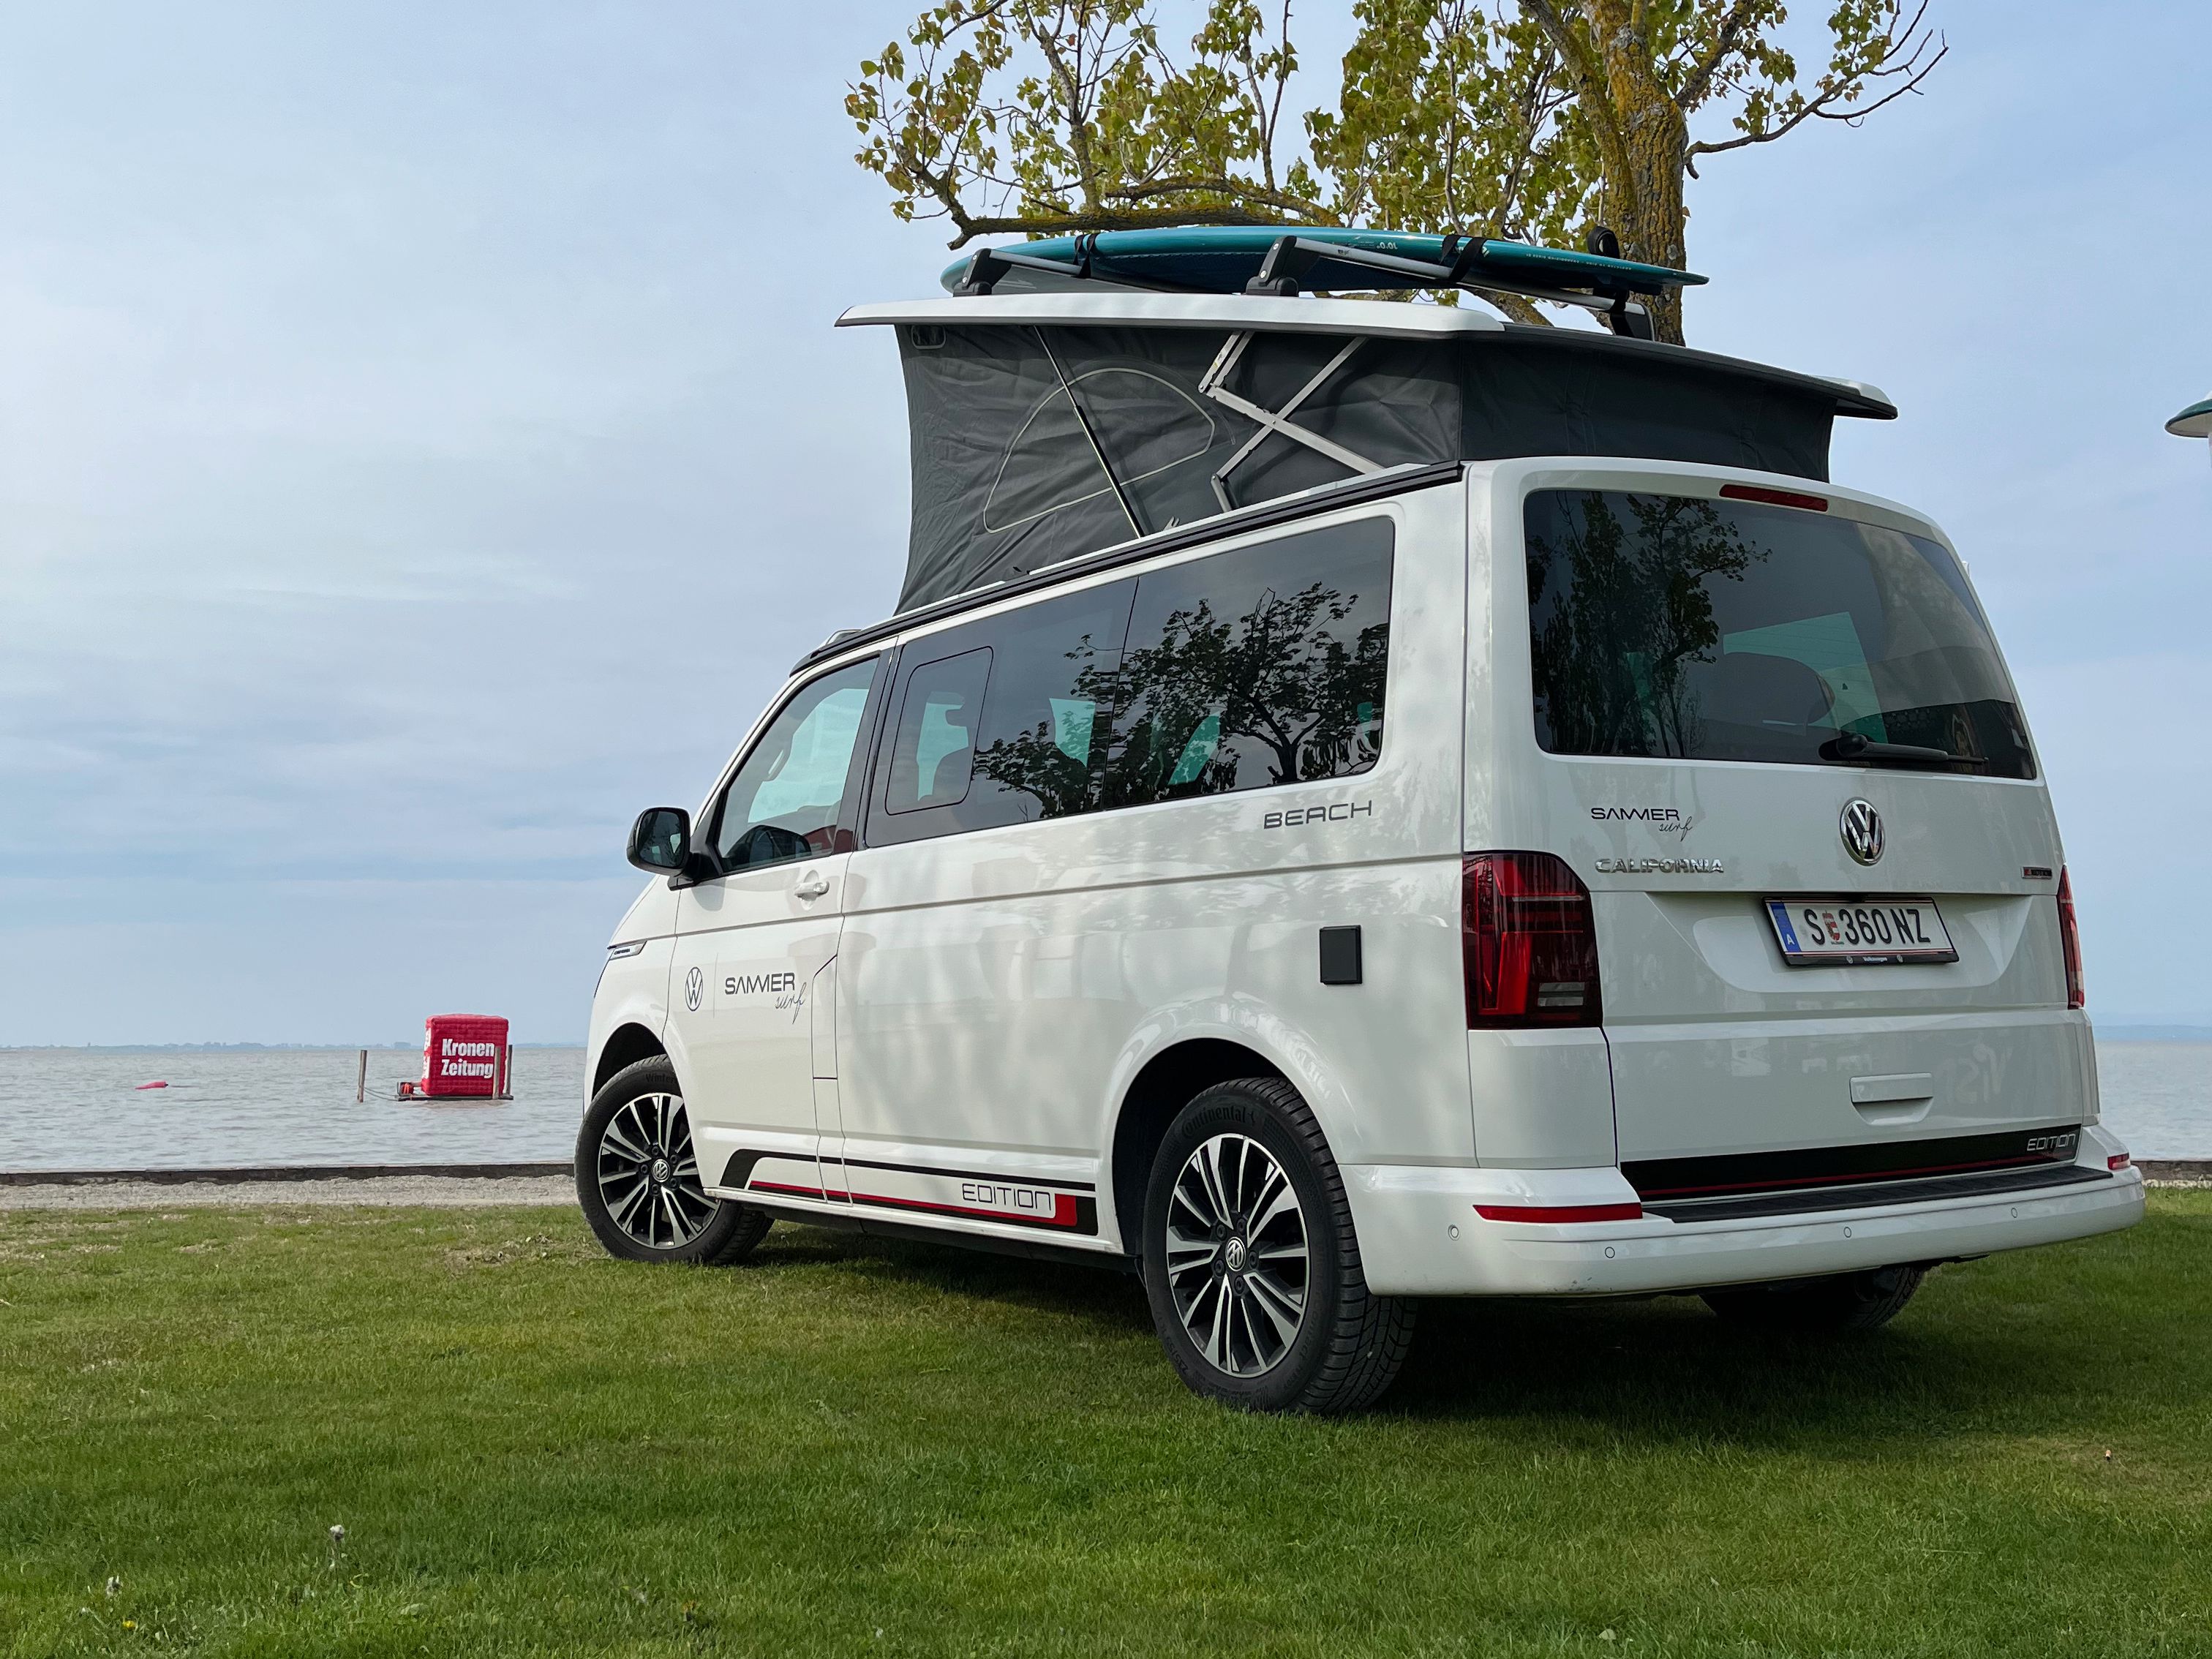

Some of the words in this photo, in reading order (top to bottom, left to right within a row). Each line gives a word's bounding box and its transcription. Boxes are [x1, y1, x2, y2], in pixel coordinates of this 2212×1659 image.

[1263, 800, 1372, 830] BEACH
[1595, 858, 1724, 873] CALIFORNIA
[1803, 908, 1826, 946] S
[1786, 933, 1795, 946] A
[441, 1038, 495, 1057] Kronen
[440, 1058, 494, 1079] Zeitung
[1181, 1105, 1246, 1138] Continental
[2026, 1133, 2076, 1151] EDITION
[962, 1183, 1052, 1211] EDITION
